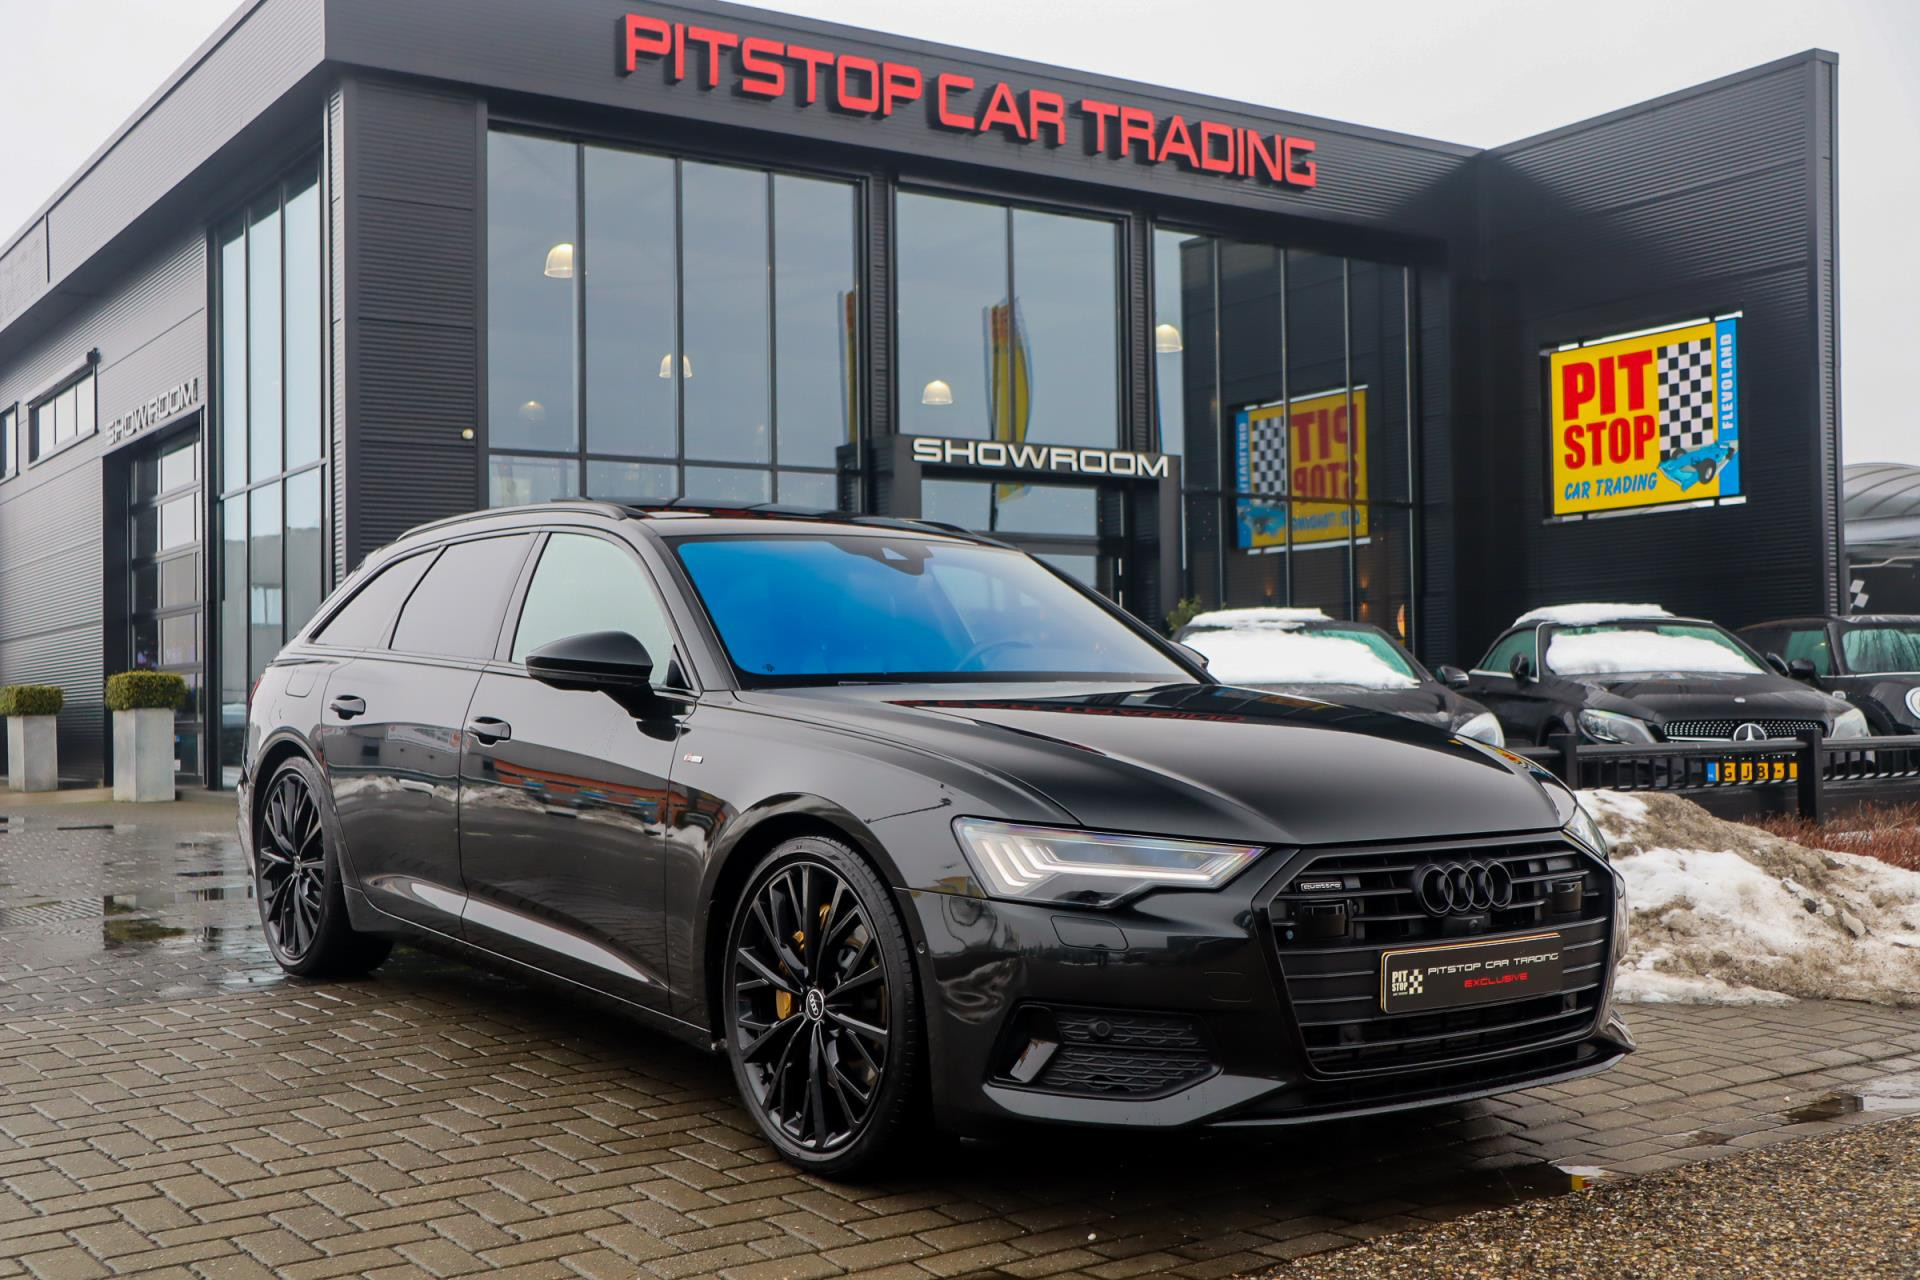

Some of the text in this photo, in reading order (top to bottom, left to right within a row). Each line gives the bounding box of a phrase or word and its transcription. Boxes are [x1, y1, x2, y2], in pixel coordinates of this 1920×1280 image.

[625, 13, 1316, 188] PITSTOP CAR TRADING
[1562, 349, 1653, 421] PIT
[1720, 333, 1734, 430] FLEVOLAND
[104, 377, 199, 446] SHOWROOM
[913, 437, 1169, 478] SHOWROOM
[1563, 414, 1656, 470] STOP
[1565, 472, 1658, 500] CAR TRADING
[1391, 970, 1408, 983] PIT
[1428, 952, 1559, 976] PITSTOP CAR TRADING
[1464, 972, 1528, 988] EXCLUSIVE
[1391, 983, 1408, 992] STOP
